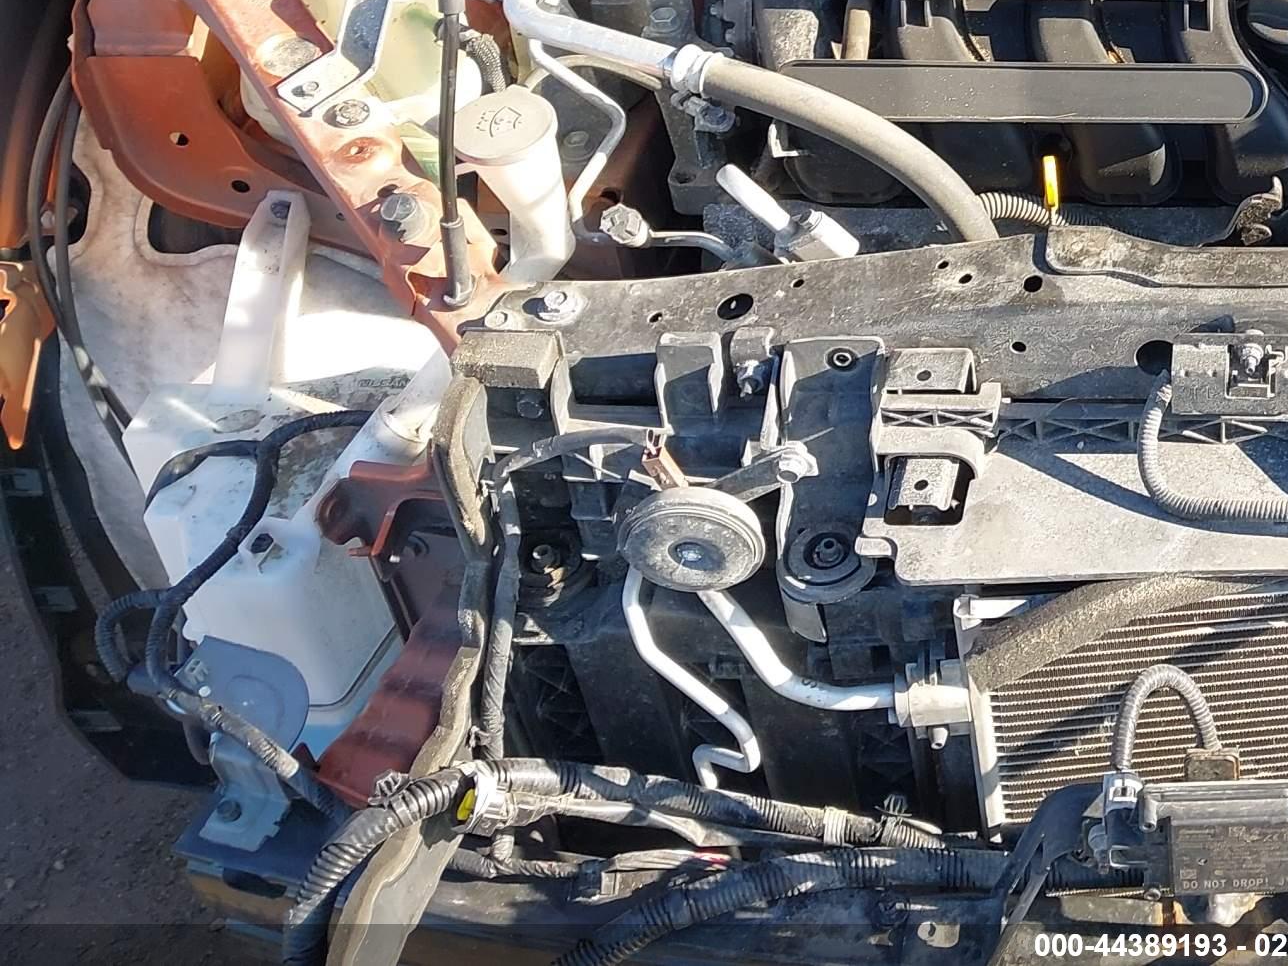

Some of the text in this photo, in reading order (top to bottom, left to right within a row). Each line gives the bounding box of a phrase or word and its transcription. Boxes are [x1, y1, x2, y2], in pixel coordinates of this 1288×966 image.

[1183, 880, 1199, 889] DO
[1204, 879, 1227, 889] NOT
[1233, 878, 1269, 888] DROP!
